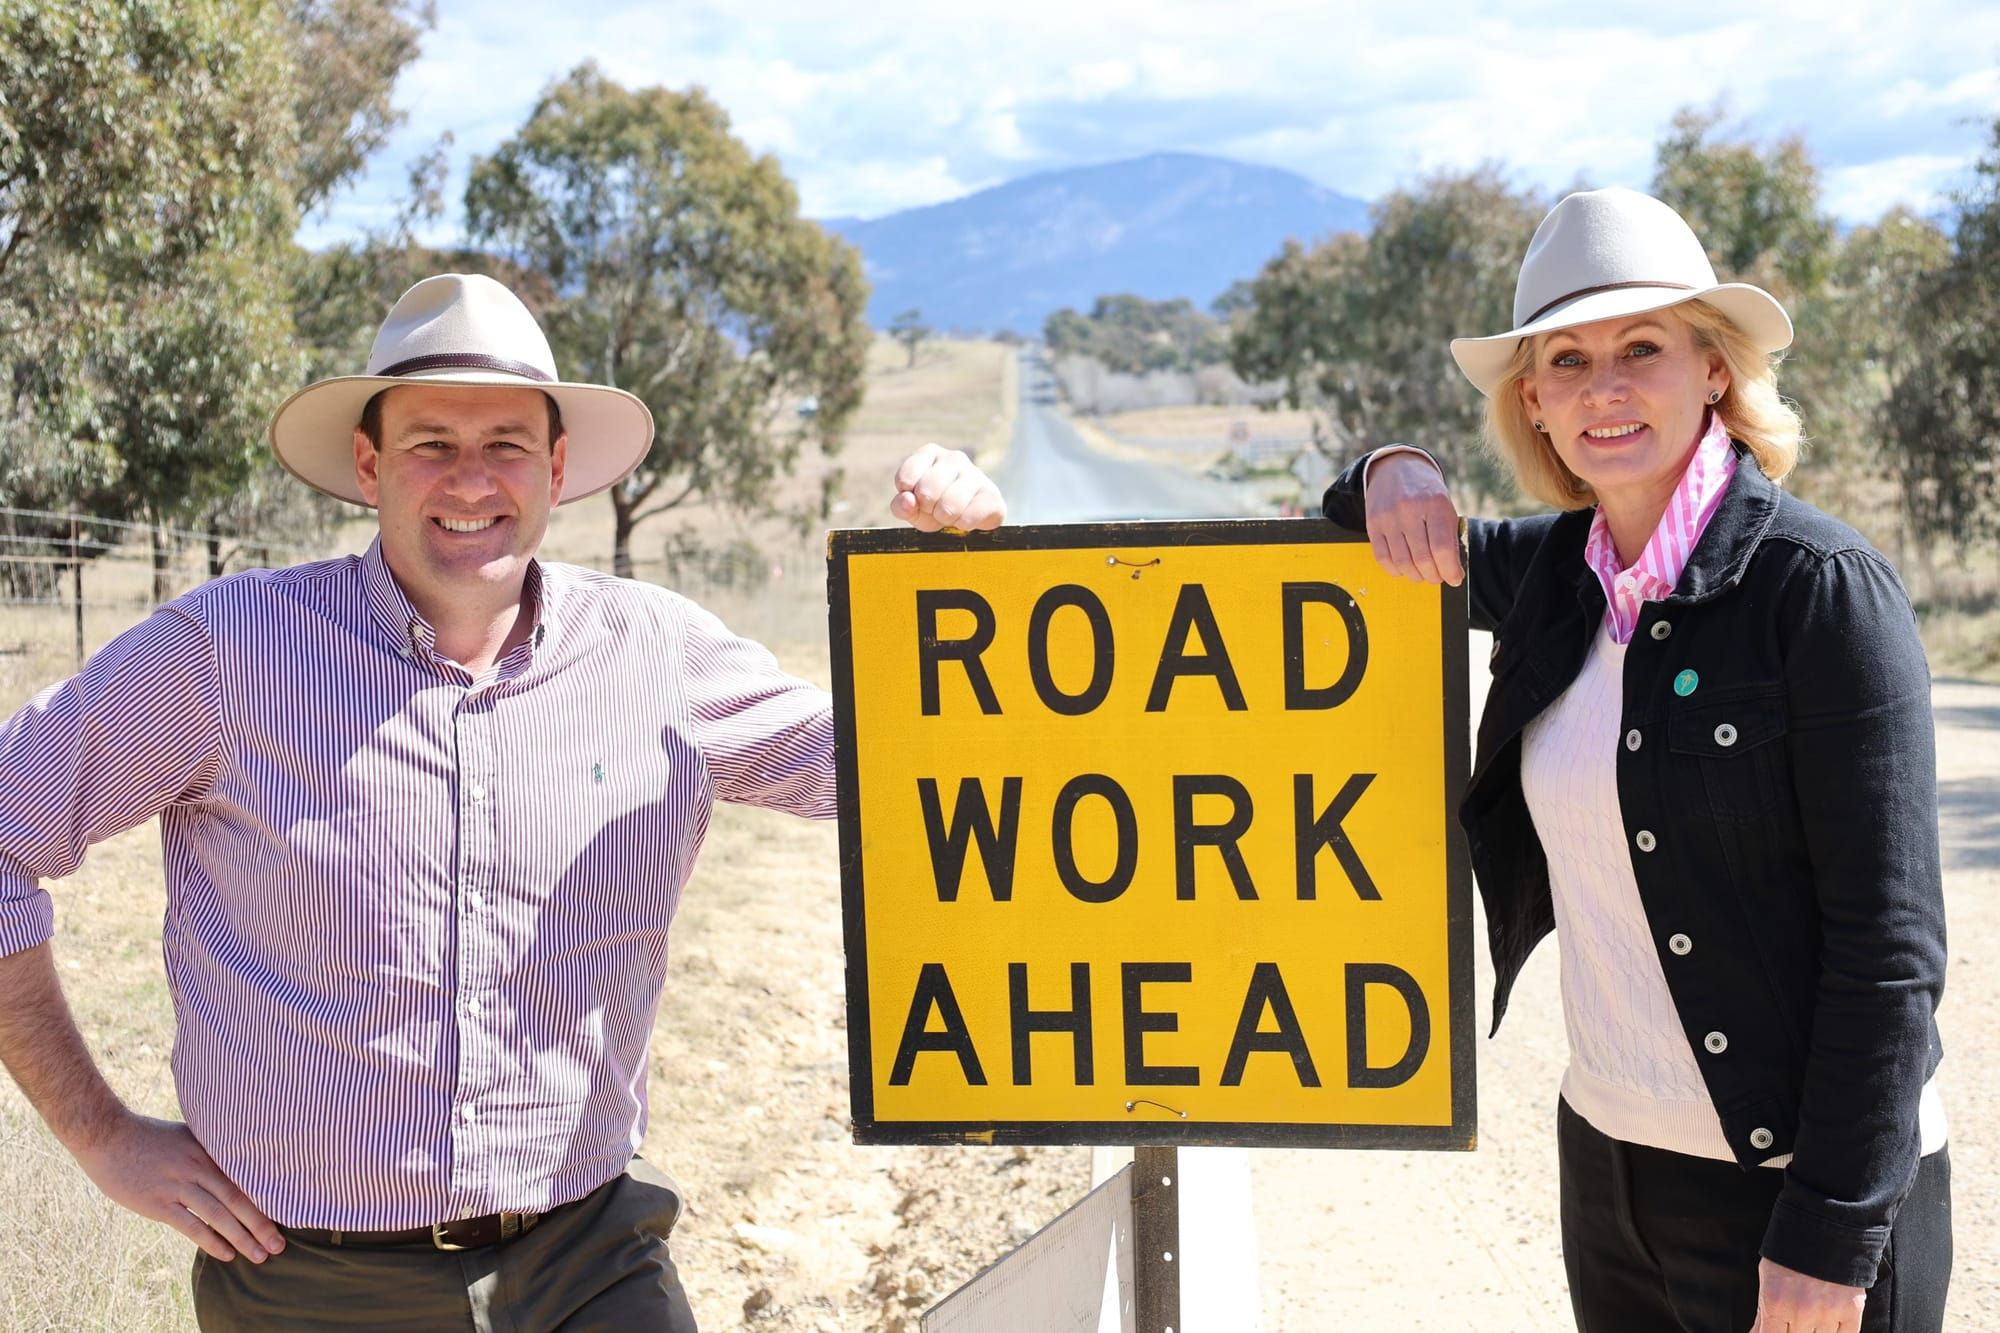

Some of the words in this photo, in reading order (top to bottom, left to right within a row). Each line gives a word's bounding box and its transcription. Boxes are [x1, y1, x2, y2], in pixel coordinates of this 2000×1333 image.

[917, 582, 1369, 715] ROAD
[918, 774, 1382, 903] WORK
[889, 963, 1430, 1088] AHEAD
